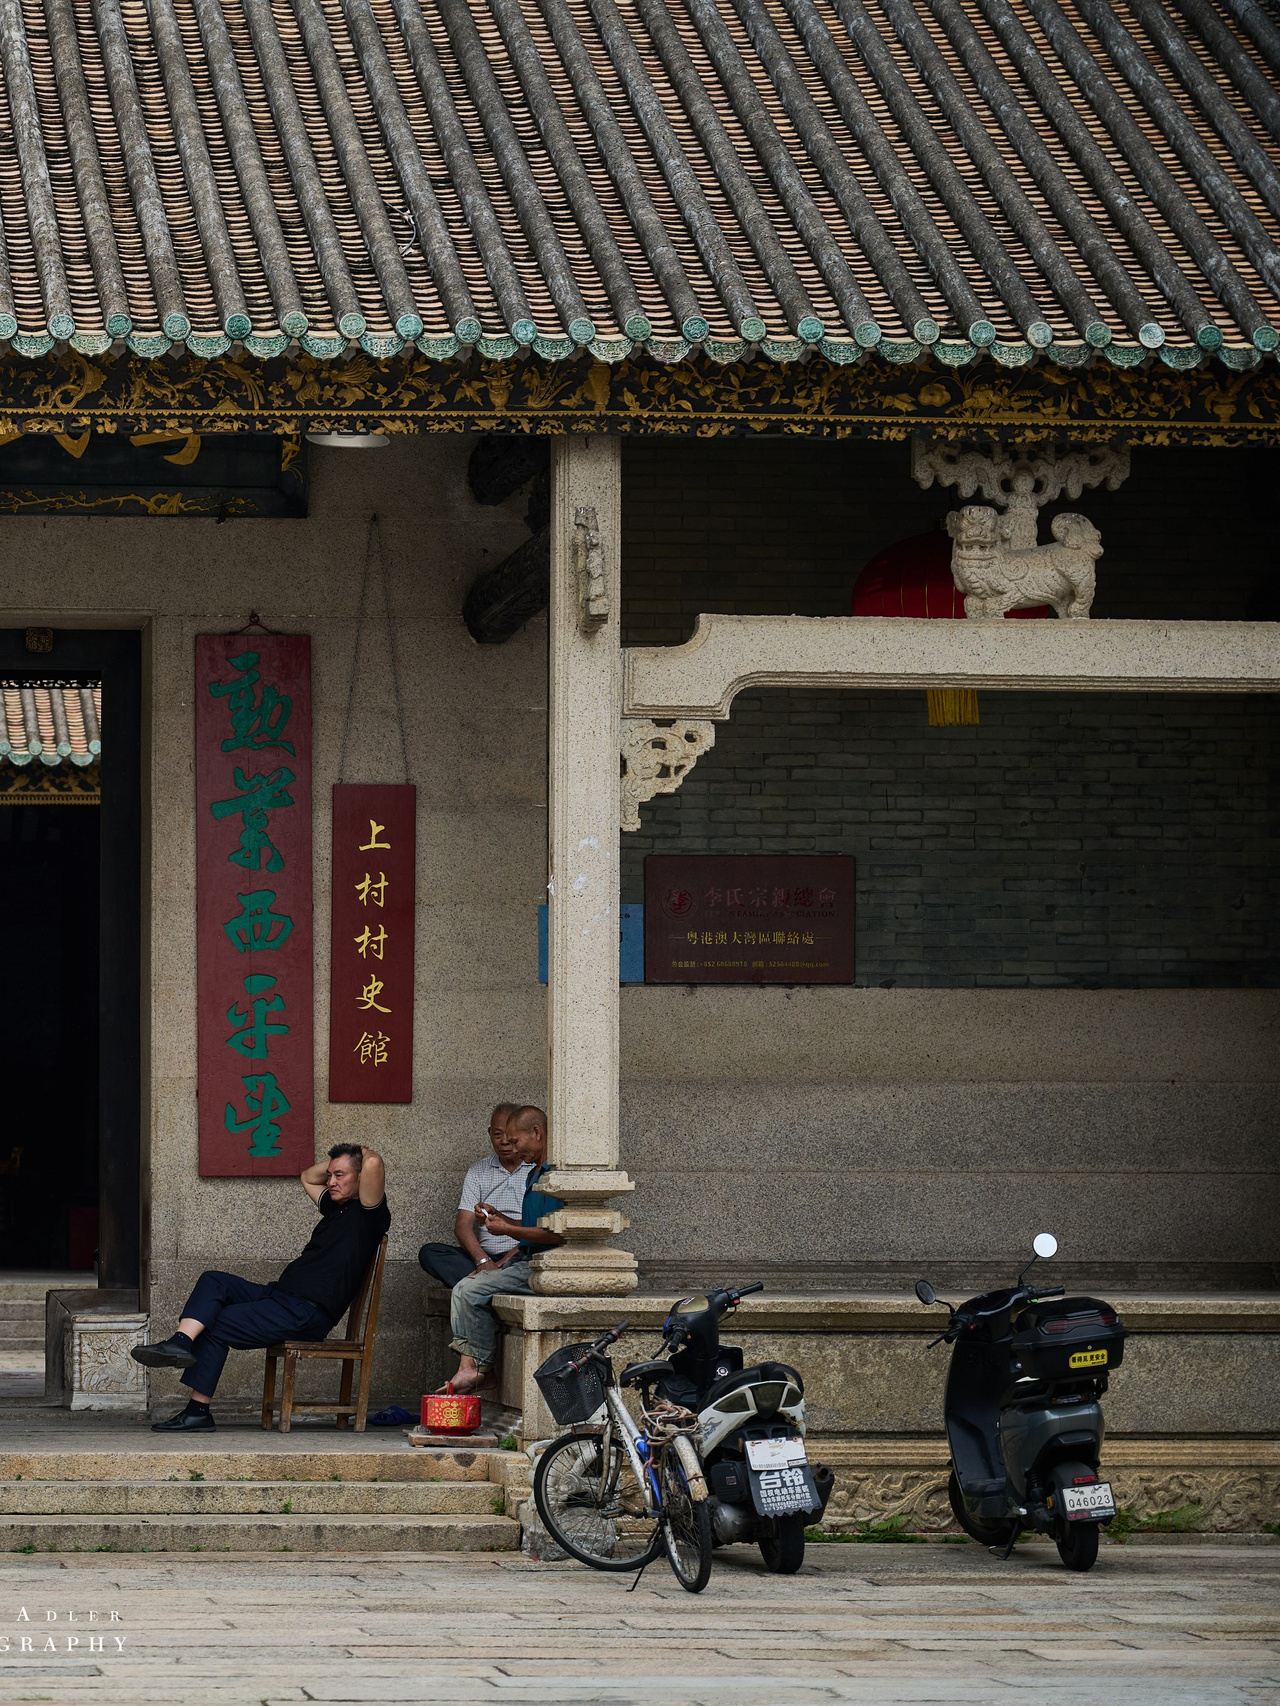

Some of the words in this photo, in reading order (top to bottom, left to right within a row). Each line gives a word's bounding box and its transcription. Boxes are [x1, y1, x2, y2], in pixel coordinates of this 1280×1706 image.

[704, 886, 837, 908] 李氏宗親總會
[353, 818, 392, 1068] 上村村史館
[759, 1467, 805, 1490] 台铃
[1068, 1494, 1111, 1509] Q46023
